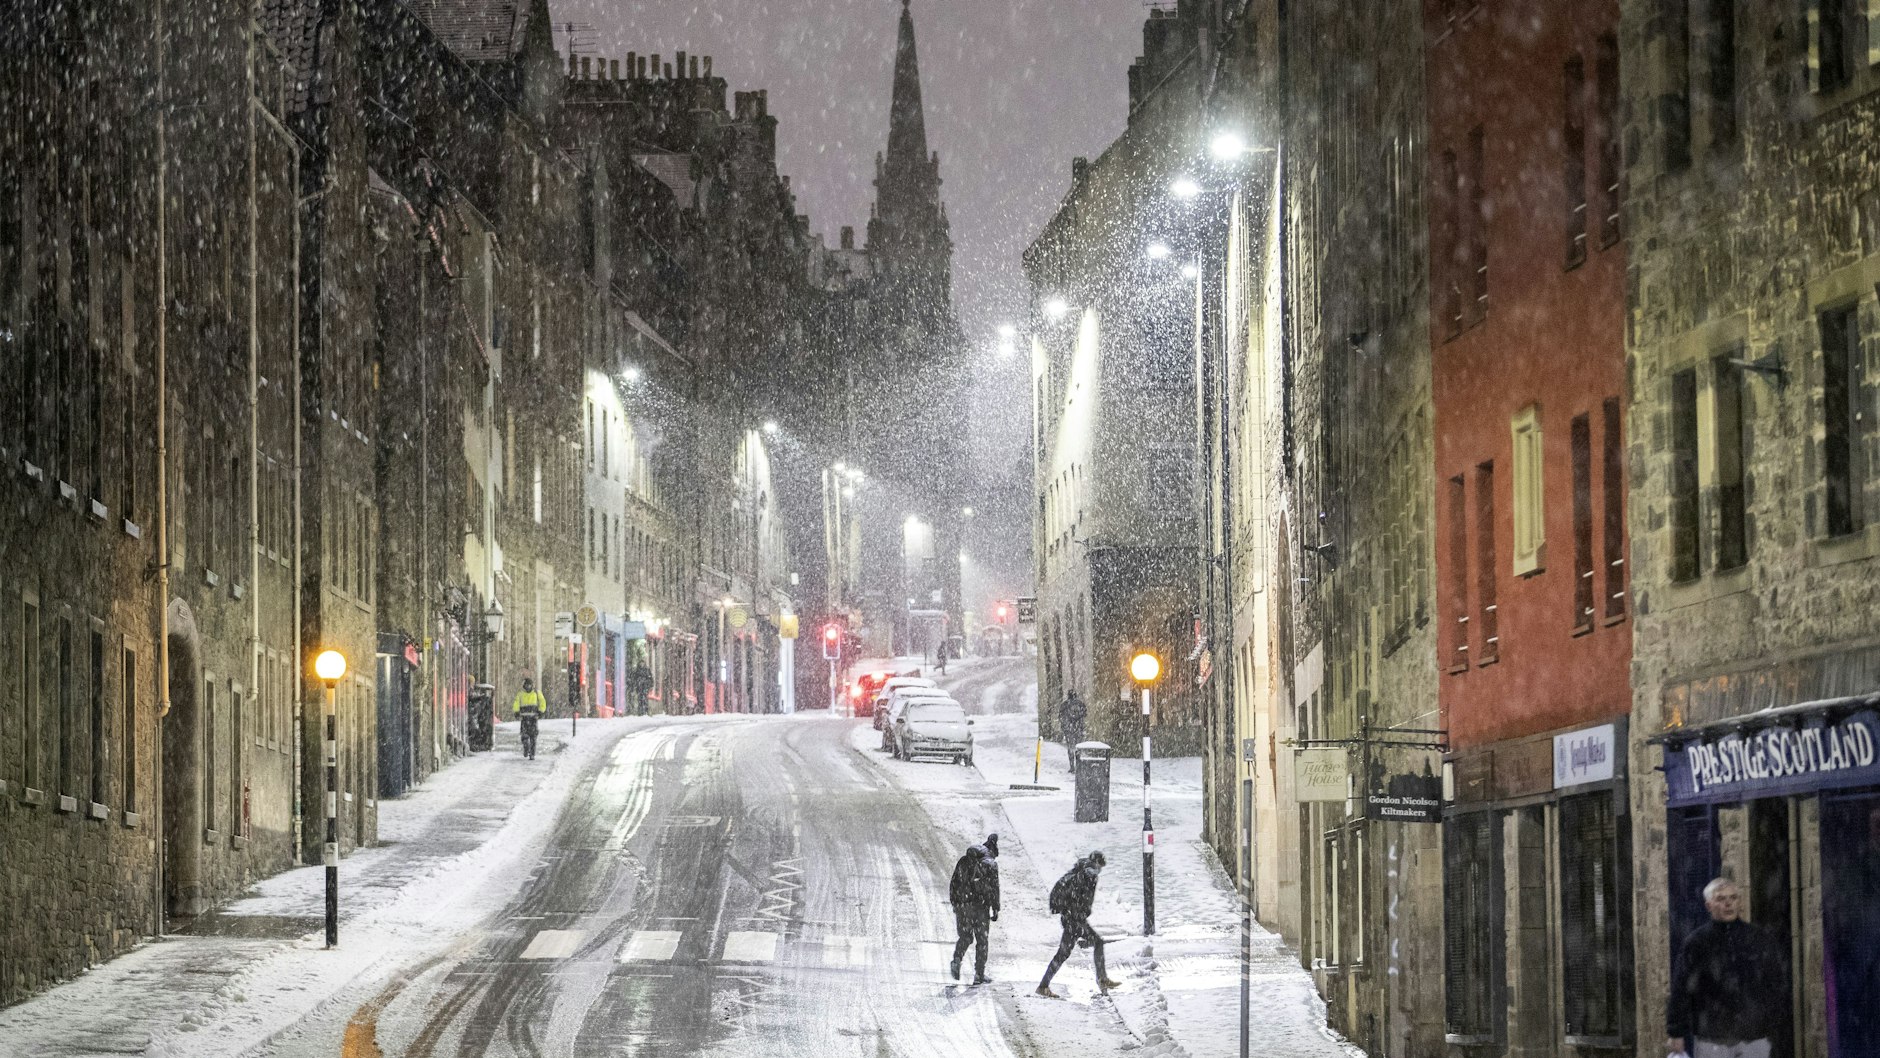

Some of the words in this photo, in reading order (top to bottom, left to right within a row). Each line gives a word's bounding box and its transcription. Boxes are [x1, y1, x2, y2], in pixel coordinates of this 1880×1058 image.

[1688, 736, 1768, 792] PRESTIGE
[1768, 722, 1873, 777] SCOTLAND
[1306, 772, 1343, 787] House
[1369, 795, 1400, 804] Gordon
[1402, 796, 1438, 806] Nicolson
[1380, 807, 1426, 816] Kiltmakers
